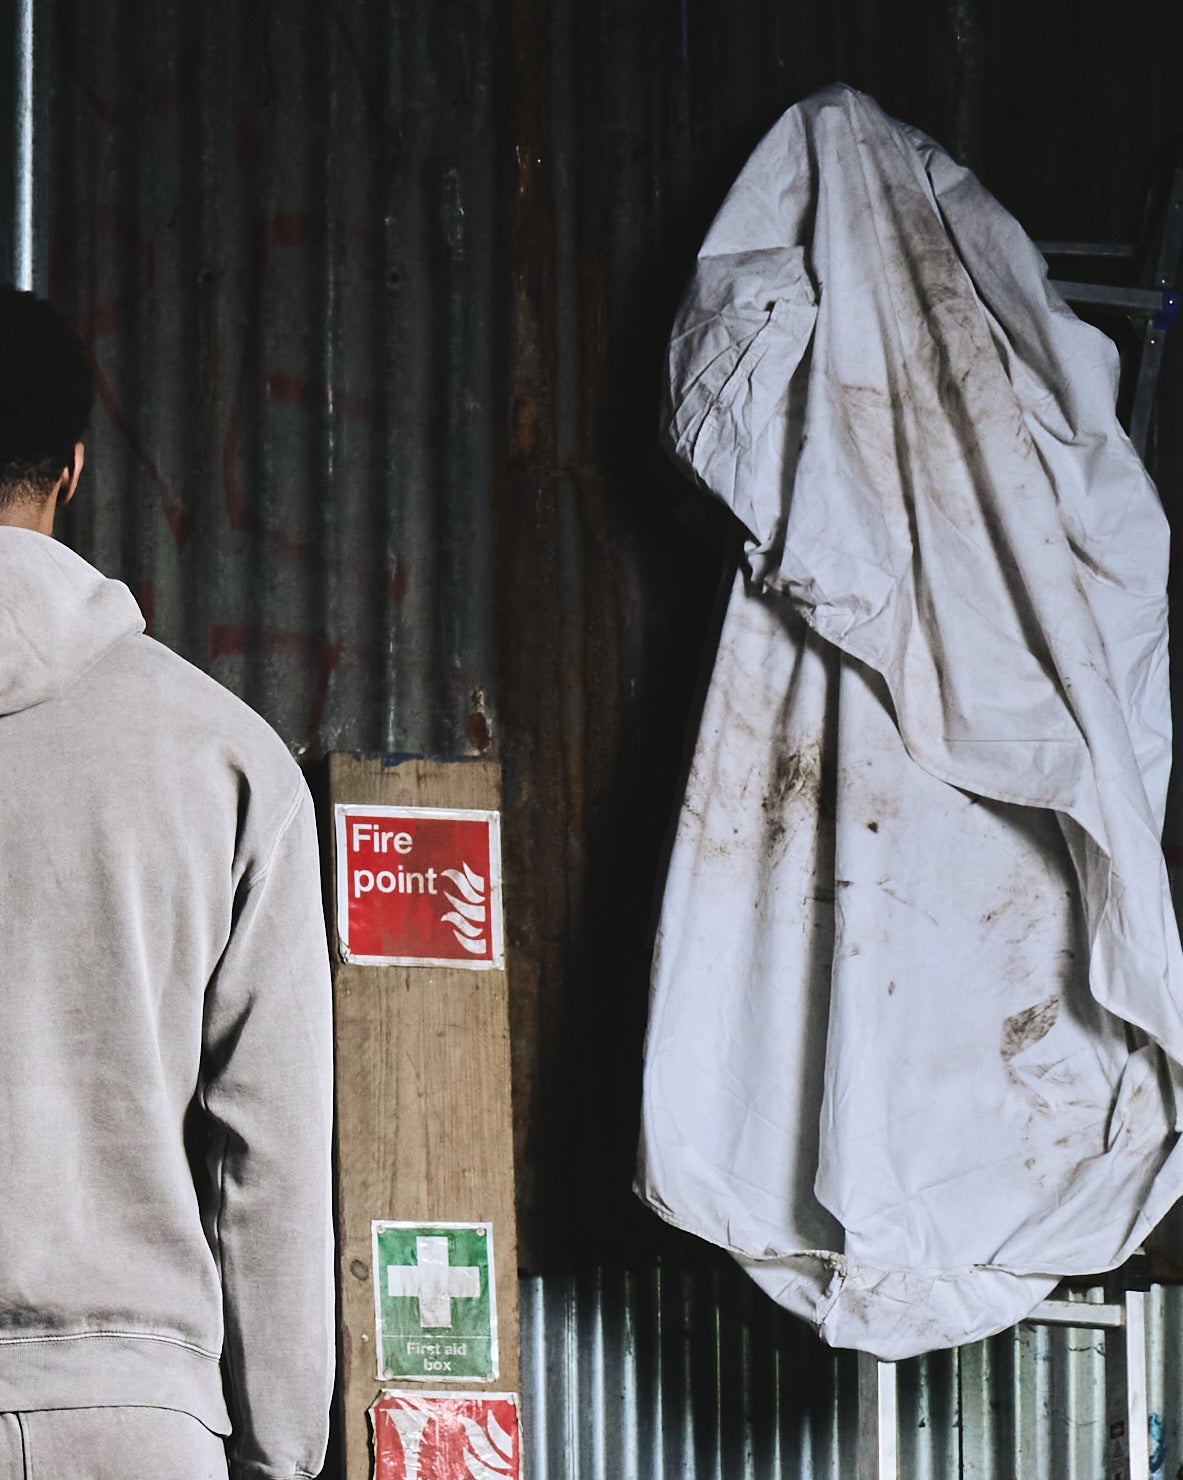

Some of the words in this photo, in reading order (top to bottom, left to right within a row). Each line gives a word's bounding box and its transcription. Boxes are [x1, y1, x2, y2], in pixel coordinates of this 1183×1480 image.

[352, 823, 413, 854] Fire
[354, 865, 438, 898] point
[406, 1342, 441, 1355] First
[444, 1343, 467, 1356] aid
[423, 1358, 452, 1371] box
